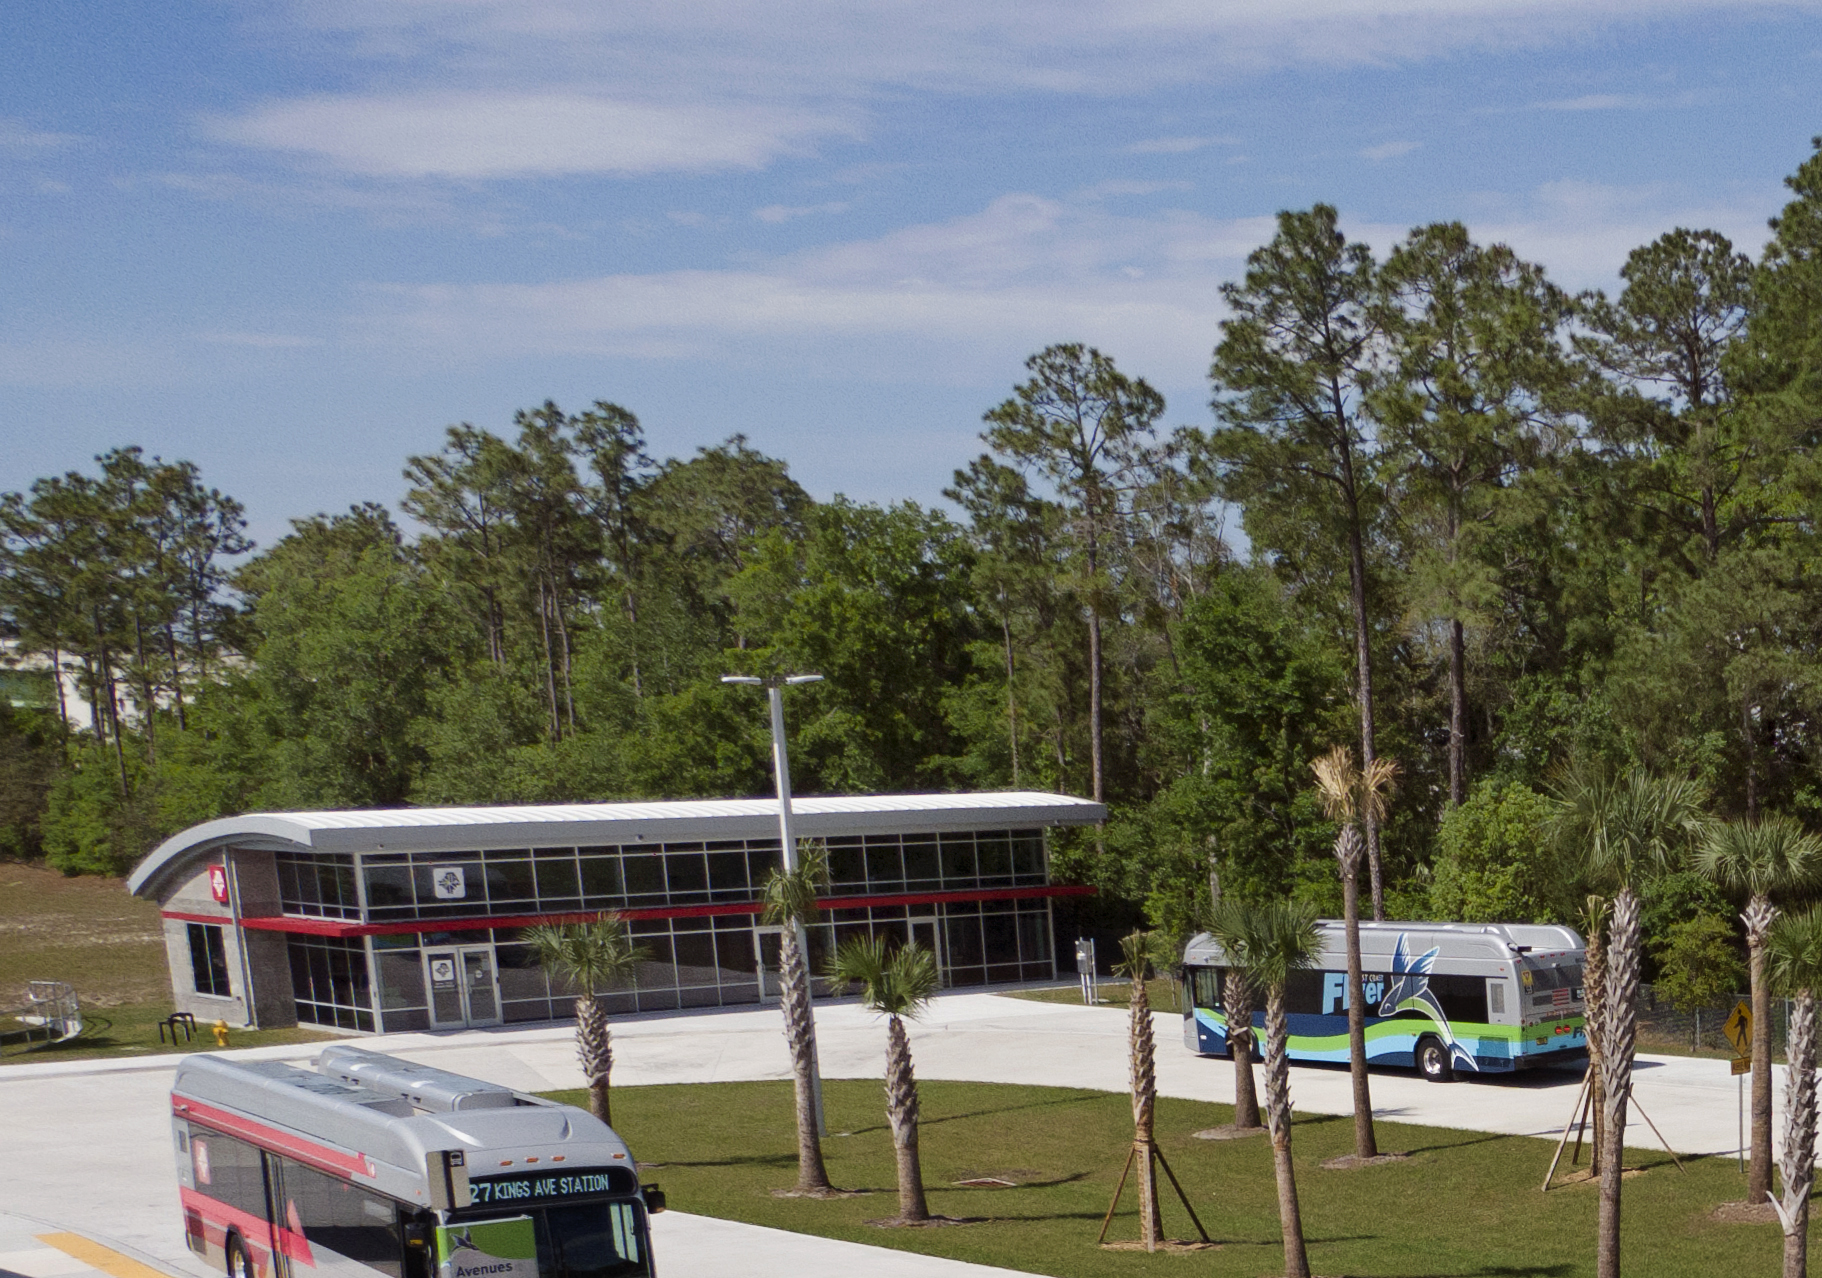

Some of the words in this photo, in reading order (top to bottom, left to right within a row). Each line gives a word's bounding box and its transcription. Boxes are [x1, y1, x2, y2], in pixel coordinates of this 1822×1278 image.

[1322, 972, 1385, 1015] Fler
[469, 1183, 492, 1203] 27
[494, 1181, 531, 1200] KINGS
[534, 1178, 557, 1197] AVE
[560, 1174, 609, 1194] STATION
[456, 1262, 513, 1278] Avenues
